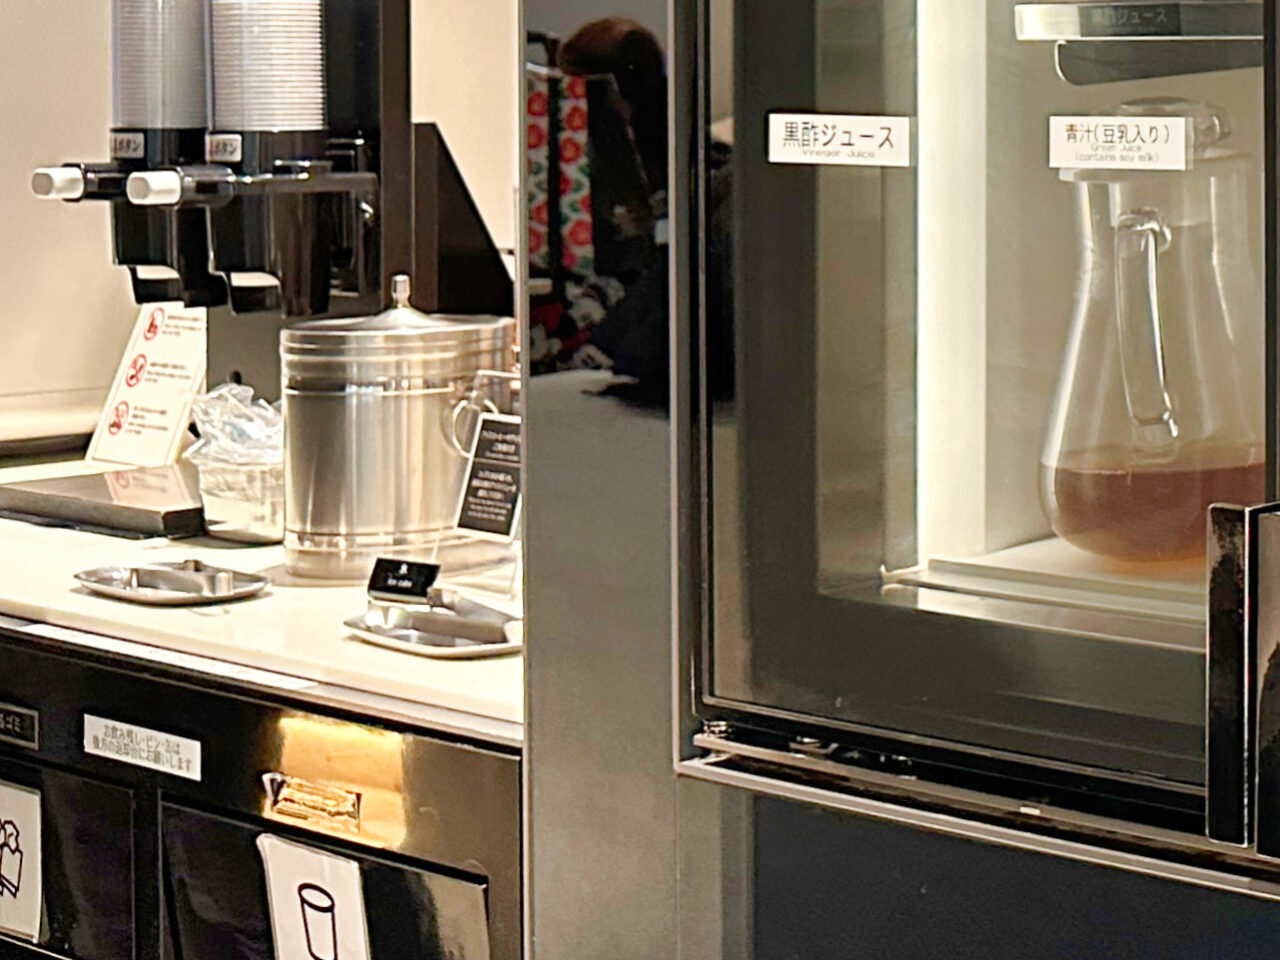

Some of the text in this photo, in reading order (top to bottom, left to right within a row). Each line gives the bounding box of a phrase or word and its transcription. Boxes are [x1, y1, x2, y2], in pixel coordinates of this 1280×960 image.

[783, 121, 894, 149] 黒酢ジュース
